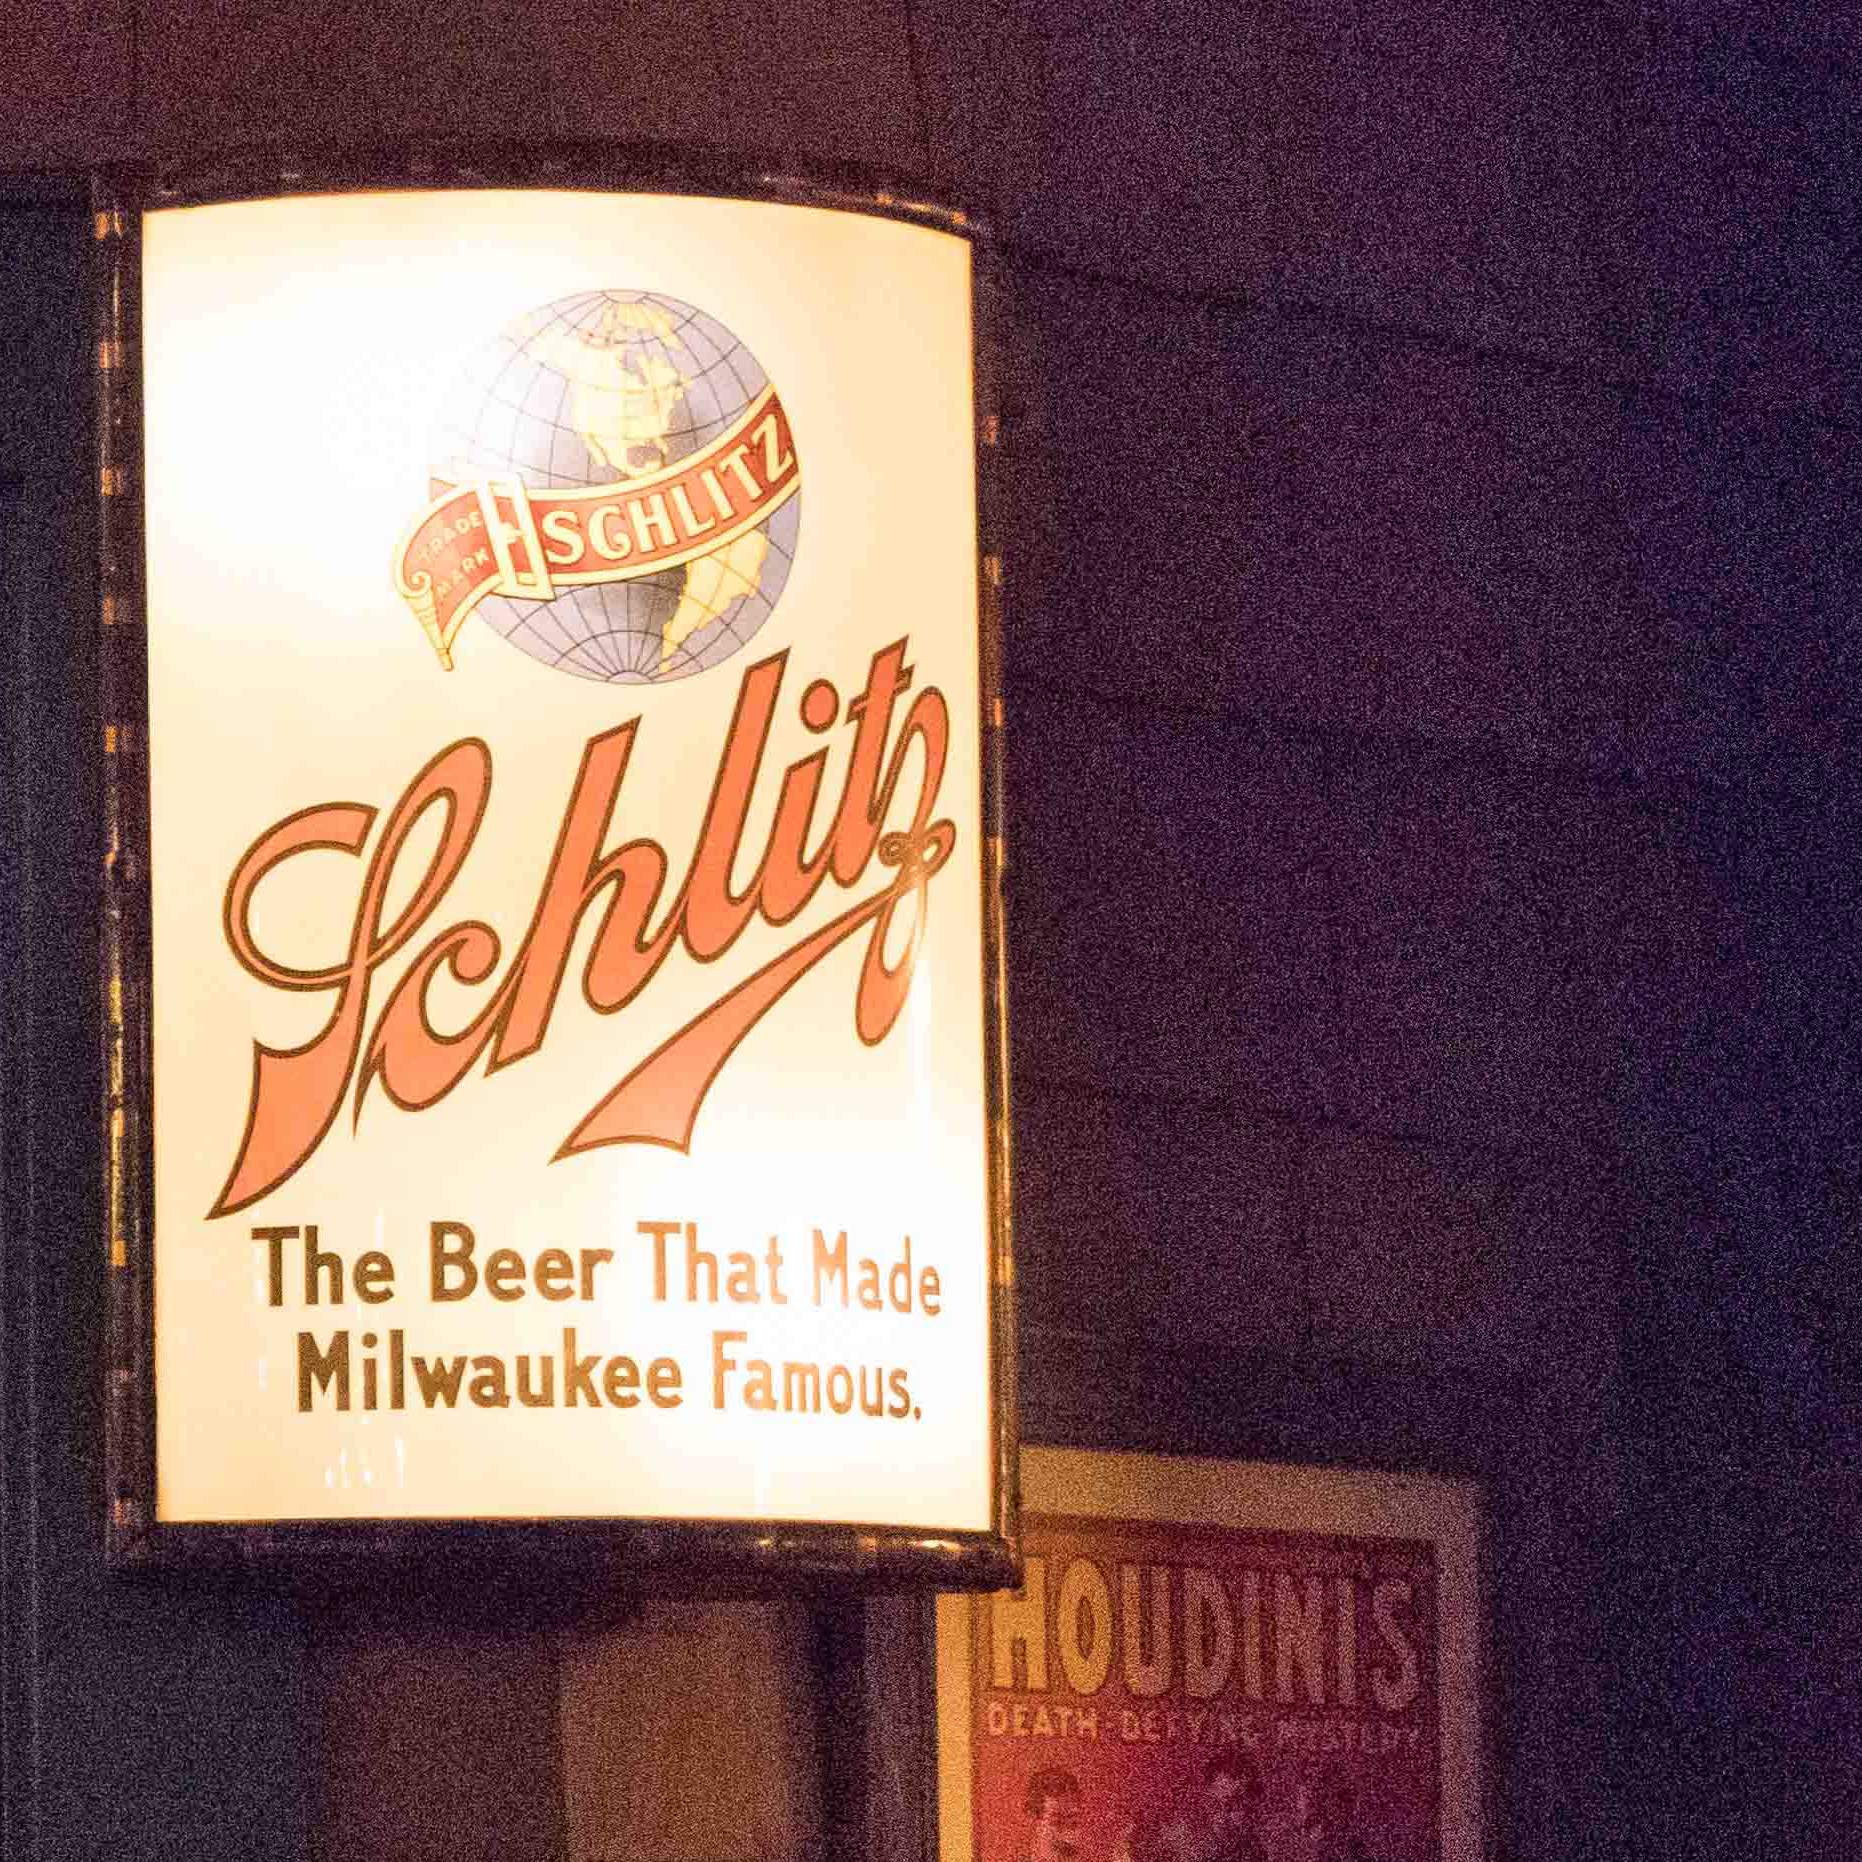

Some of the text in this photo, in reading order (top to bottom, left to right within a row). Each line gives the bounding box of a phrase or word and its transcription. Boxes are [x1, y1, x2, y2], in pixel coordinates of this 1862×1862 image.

[542, 412, 795, 566] SCHLITZ
[203, 634, 957, 1221] Schlitz
[251, 1221, 943, 1316] The Beer That Made
[297, 1327, 923, 1421] Milwaukee Famous.
